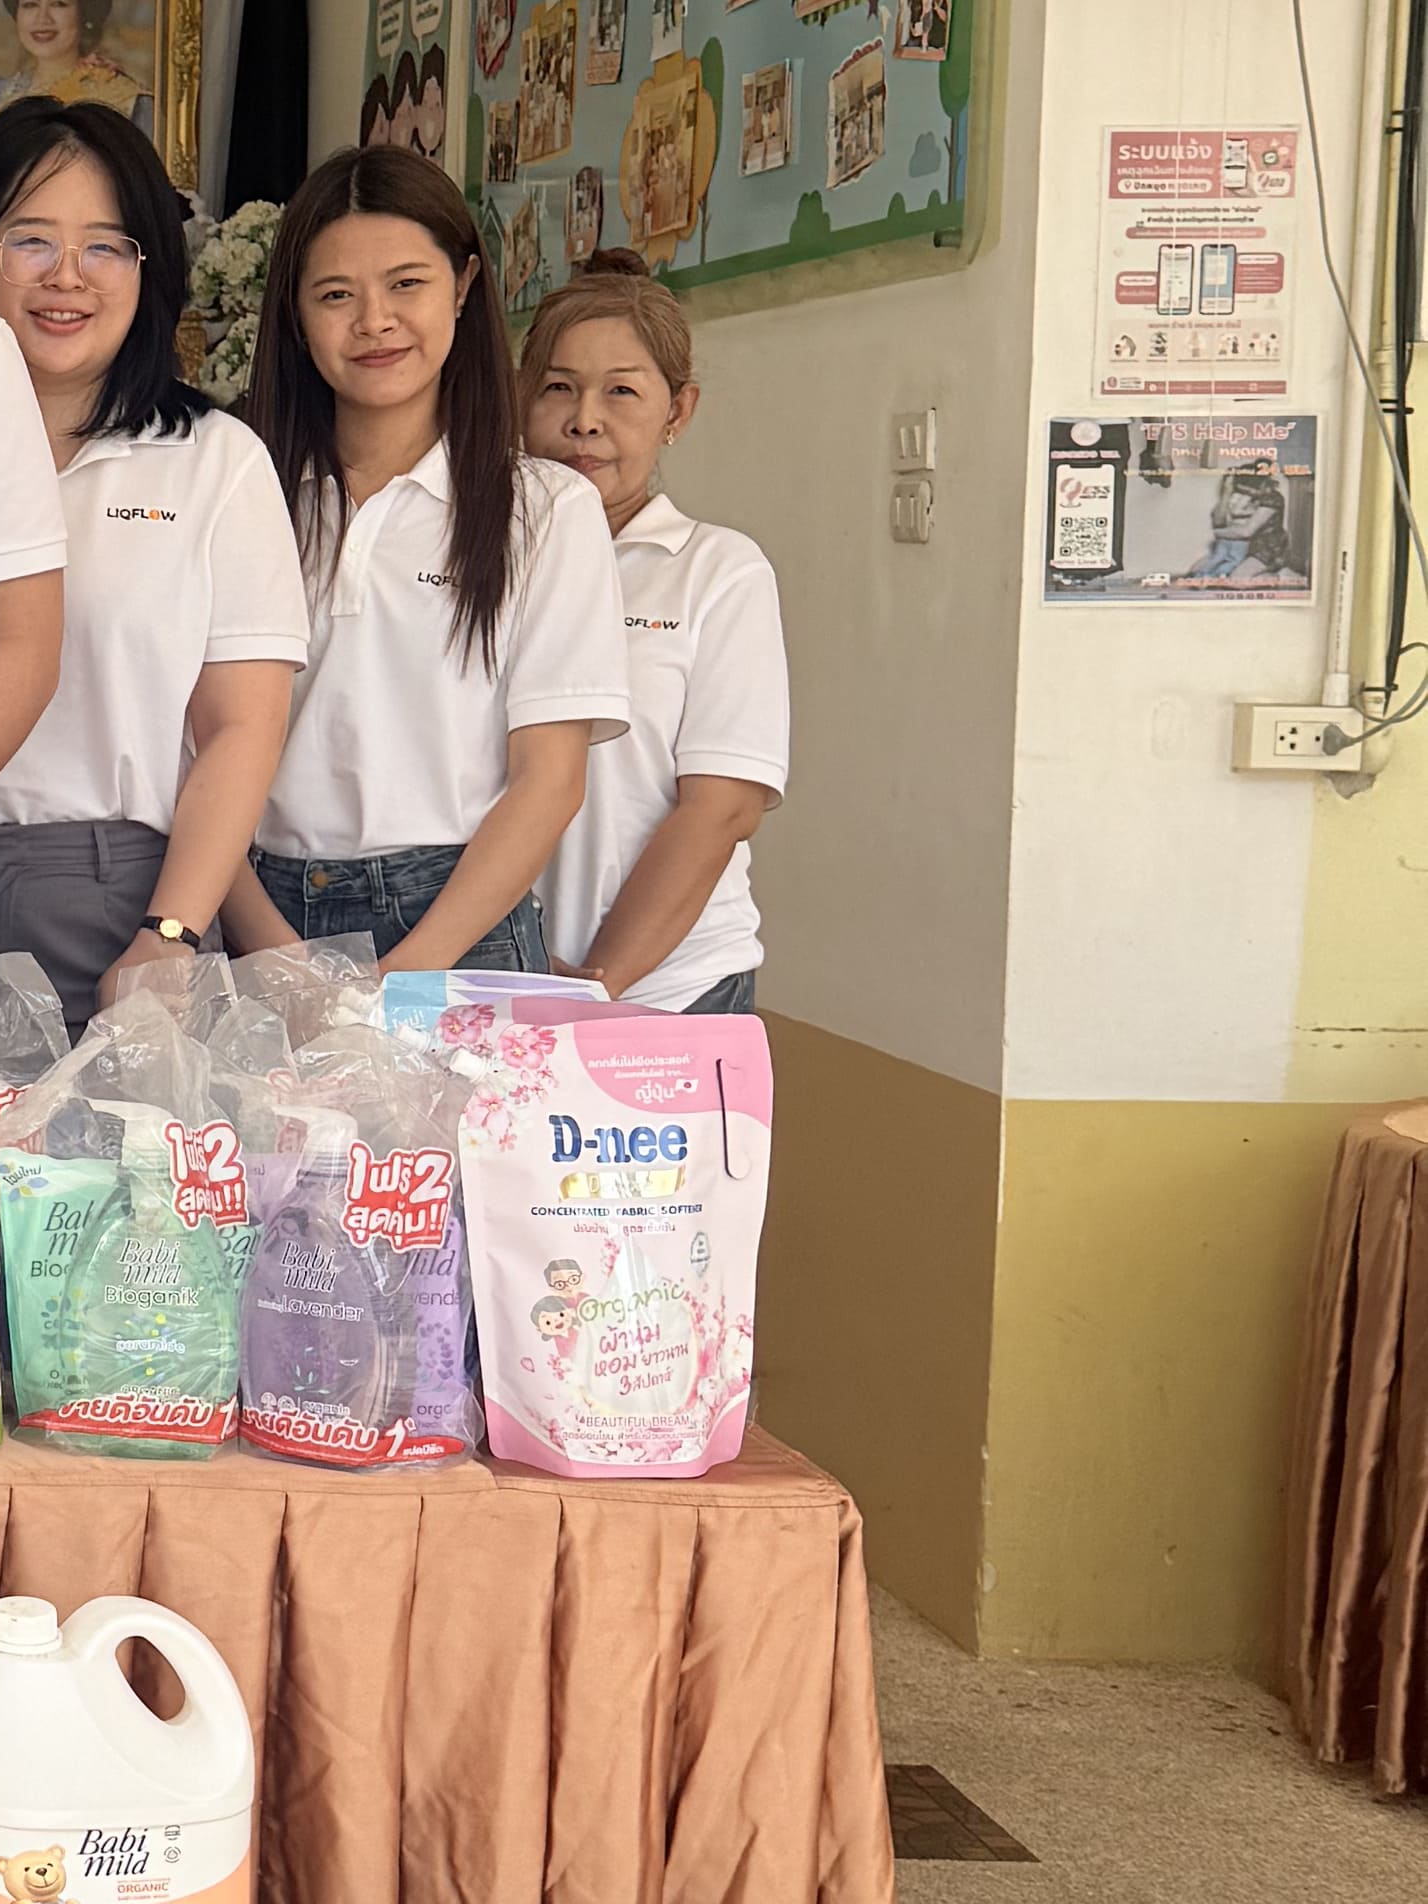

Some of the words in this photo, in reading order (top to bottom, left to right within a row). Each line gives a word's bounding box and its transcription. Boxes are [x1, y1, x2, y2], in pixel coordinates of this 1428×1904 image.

[1194, 423, 1248, 444] Help
[106, 507, 177, 523] LIQFLOW
[417, 571, 461, 589] LIQFL
[624, 616, 680, 631] QFLOW
[549, 1114, 688, 1163] D-nee
[119, 1239, 179, 1264] Babi
[281, 1242, 336, 1267] Babi
[105, 1286, 199, 1309] Bioganik
[77, 1827, 150, 1856] Babi
